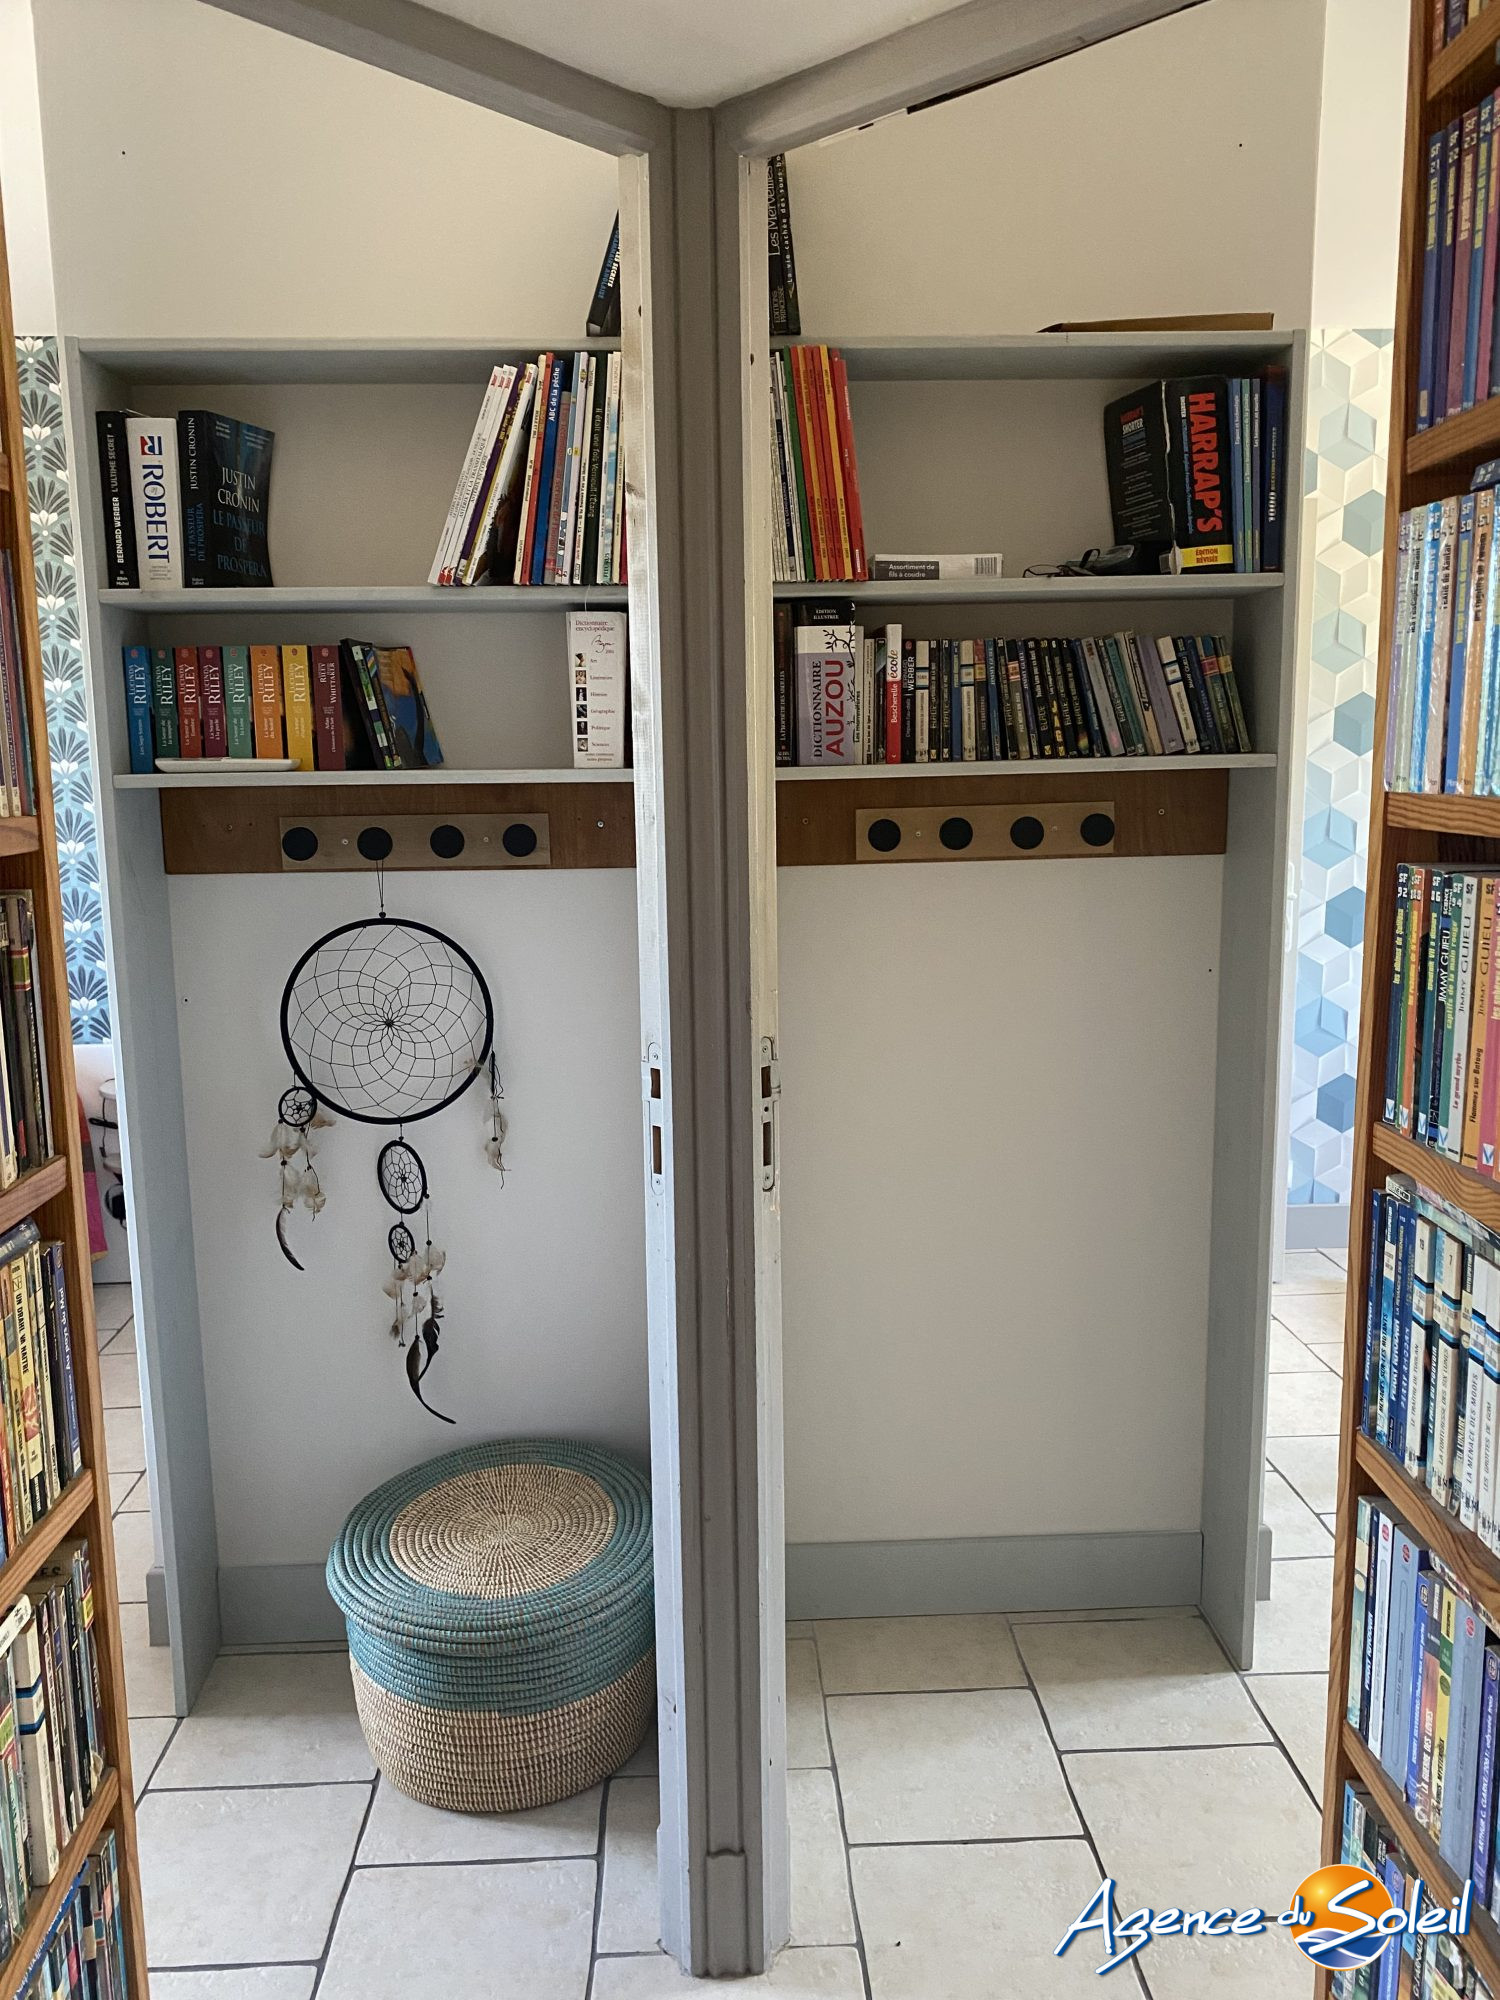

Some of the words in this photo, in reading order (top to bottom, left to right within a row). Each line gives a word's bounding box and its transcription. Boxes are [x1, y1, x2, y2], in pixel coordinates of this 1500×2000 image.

[1465, 116, 1478, 132] SF
[1481, 105, 1492, 121] SF
[1430, 142, 1441, 158] SF
[1449, 131, 1459, 147] SF
[768, 231, 781, 256] Les
[549, 366, 562, 388] pêche
[549, 387, 558, 396] la
[549, 396, 557, 407] de
[546, 405, 557, 422] ABC
[593, 415, 603, 432] était
[188, 417, 197, 457] CRONIN
[1122, 418, 1145, 436] SHORTER
[107, 434, 116, 460] SECRET
[592, 433, 600, 448] une
[591, 448, 600, 462] fois
[1188, 392, 1223, 533] HARRAP'S
[109, 460, 119, 492] L'ULTIME
[188, 457, 199, 490] JUSTIN
[221, 466, 256, 491] JUSTIN
[217, 488, 260, 513] CRONIN
[1462, 503, 1473, 515] SF
[1480, 496, 1491, 508] SF
[112, 497, 120, 529] WERBER
[142, 464, 170, 563] ROBERT
[213, 509, 225, 526] LE
[1429, 513, 1440, 524] SF
[1460, 519, 1473, 533] 50
[114, 529, 125, 564] BERNARD
[234, 536, 247, 552] DE
[217, 554, 267, 577] PROSPERA
[888, 563, 925, 571] Assortiment
[926, 563, 936, 571] de
[888, 571, 898, 579] fils
[904, 571, 926, 579] coudre
[319, 664, 327, 683] RILEY
[887, 649, 899, 679] école
[907, 656, 915, 691] WERBER
[133, 663, 147, 705] RILEY
[160, 665, 174, 705] RILEY
[183, 663, 197, 704] RILEY
[208, 664, 221, 705] RILEY
[232, 663, 246, 704] RILEY
[262, 663, 275, 703] RILEY
[293, 662, 306, 702] RILEY
[812, 661, 823, 758] DICTIONNAIRE
[824, 660, 845, 757] AUZOU
[1398, 872, 1408, 883] SF
[1432, 876, 1441, 887] SF
[1452, 882, 1463, 894] SF
[1465, 883, 1474, 894] SF
[1485, 883, 1495, 895] SF
[1397, 887, 1408, 898] 92
[1451, 920, 1459, 948] rouge
[1459, 915, 1472, 974] GUIEU
[1439, 929, 1450, 966] GUIEU
[1479, 916, 1492, 976] GUIEU
[1449, 949, 1457, 972] main
[1436, 968, 1448, 1003] JIMMY
[1447, 983, 1455, 995] de
[1448, 973, 1455, 982] la
[1458, 977, 1467, 1014] JIMMY
[1477, 981, 1487, 1017] JIMMY
[1445, 996, 1455, 1030] captifs
[1454, 1052, 1462, 1077] mythe
[1453, 1078, 1461, 1099] grand
[1452, 1100, 1459, 1109] Le
[15, 1292, 24, 1306] UN
[57, 1286, 66, 1310] Mal
[16, 1306, 27, 1333] DRAHL
[60, 1310, 69, 1325] du
[18, 1332, 27, 1345] VA
[62, 1326, 71, 1352] pays
[1380, 1312, 1389, 1347] MUTANTS
[1402, 1326, 1410, 1371] RHODAN
[64, 1354, 73, 1370] Au
[1379, 1361, 1387, 1378] SUR
[1400, 1375, 1408, 1410] PERRY
[1471, 1373, 1479, 1407] MOOFS
[1485, 1421, 1491, 1436] DE
[1467, 1432, 1476, 1469] MENACE
[1466, 1471, 1472, 1484] LA
[1477, 1818, 1486, 1854] ARTHUR
